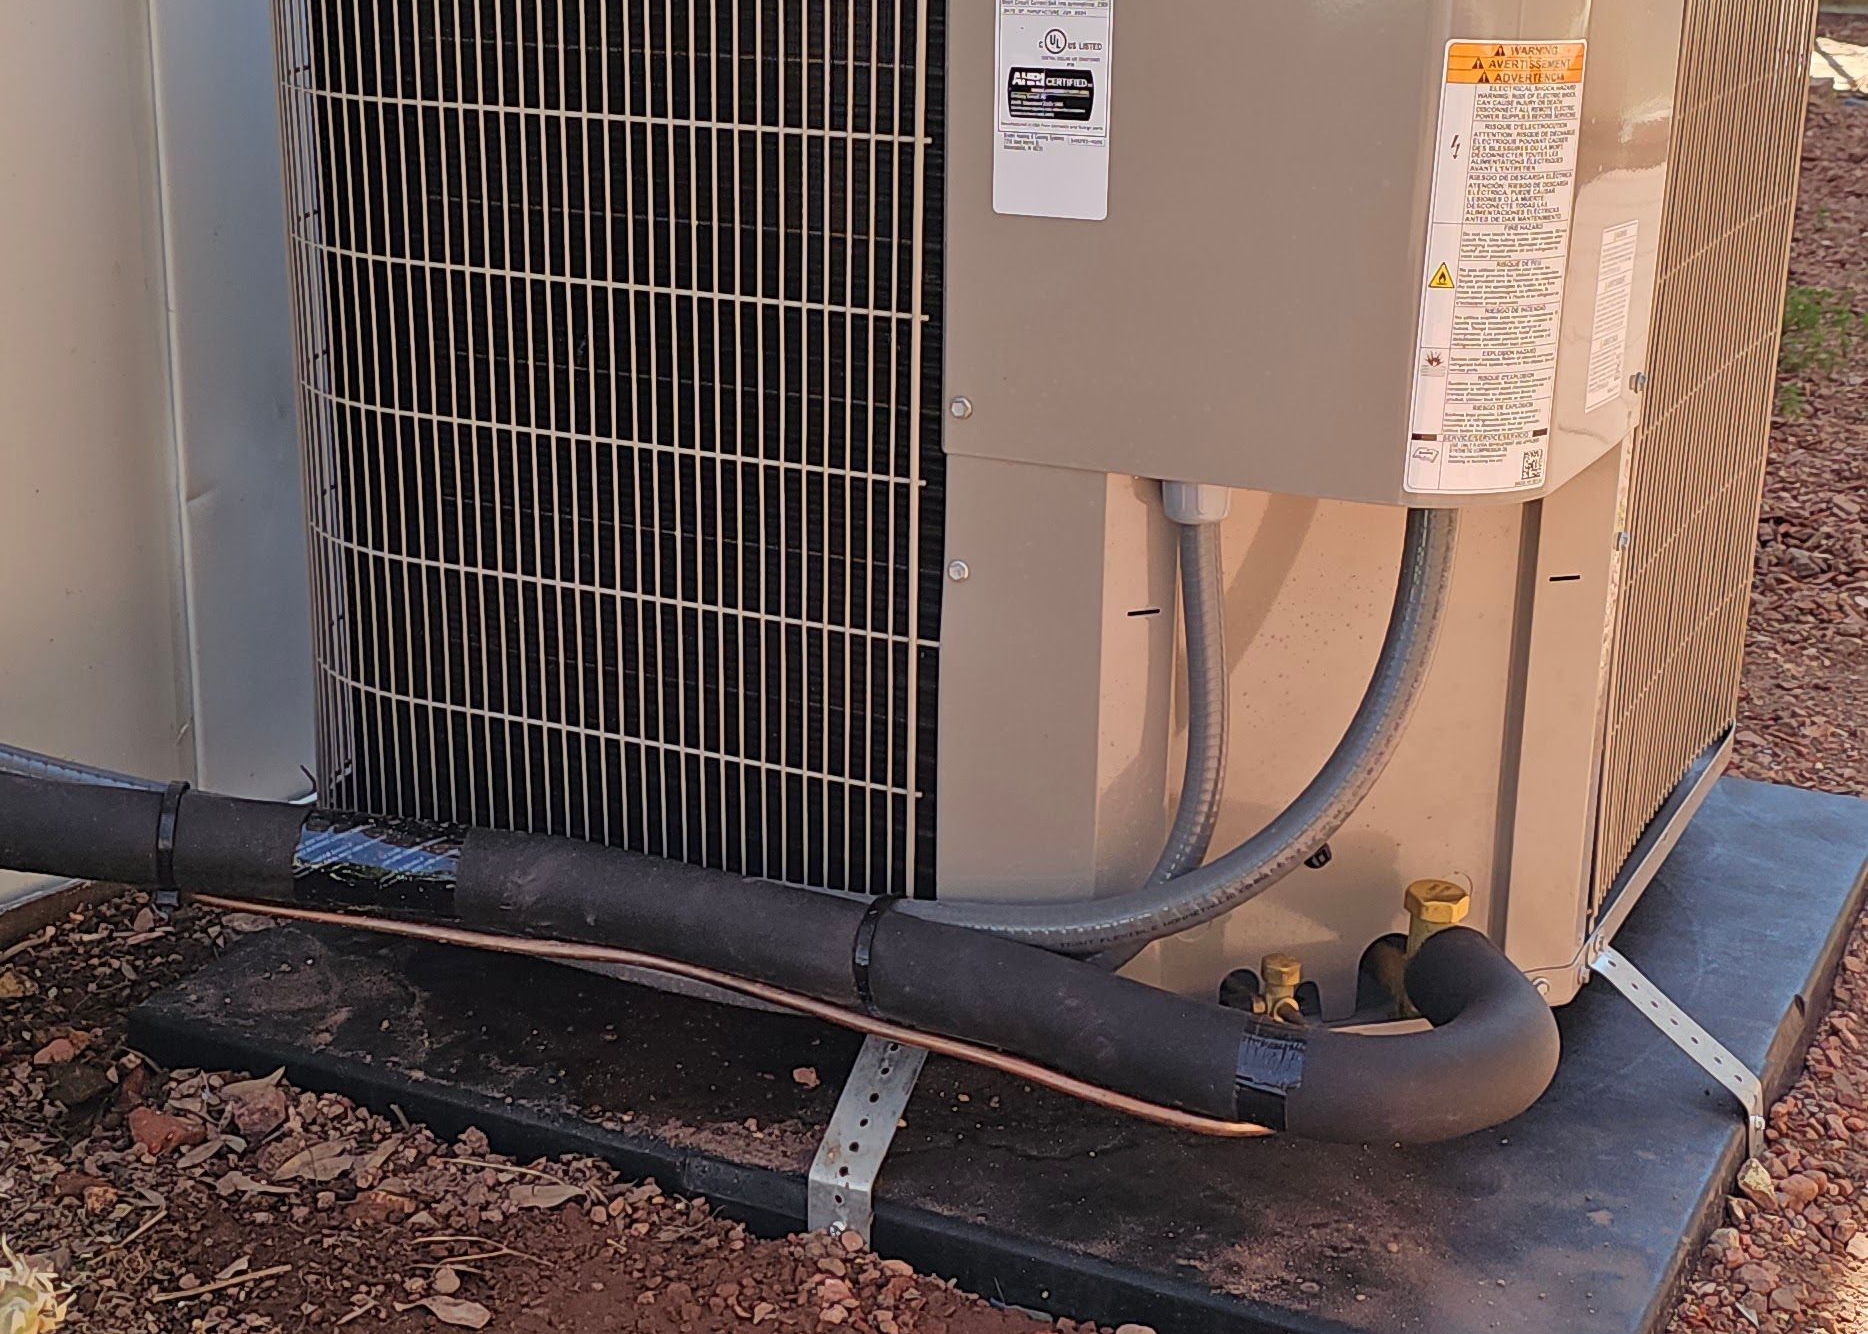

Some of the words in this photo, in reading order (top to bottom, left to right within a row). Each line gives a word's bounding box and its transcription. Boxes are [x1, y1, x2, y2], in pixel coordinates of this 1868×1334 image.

[1050, 35, 1061, 49] UL
[1511, 46, 1558, 55] WARNING
[1488, 59, 1571, 69] AVERTISSEMENT
[1046, 77, 1087, 87] CERTIFIED
[1494, 72, 1564, 83] ADVERTENCIA
